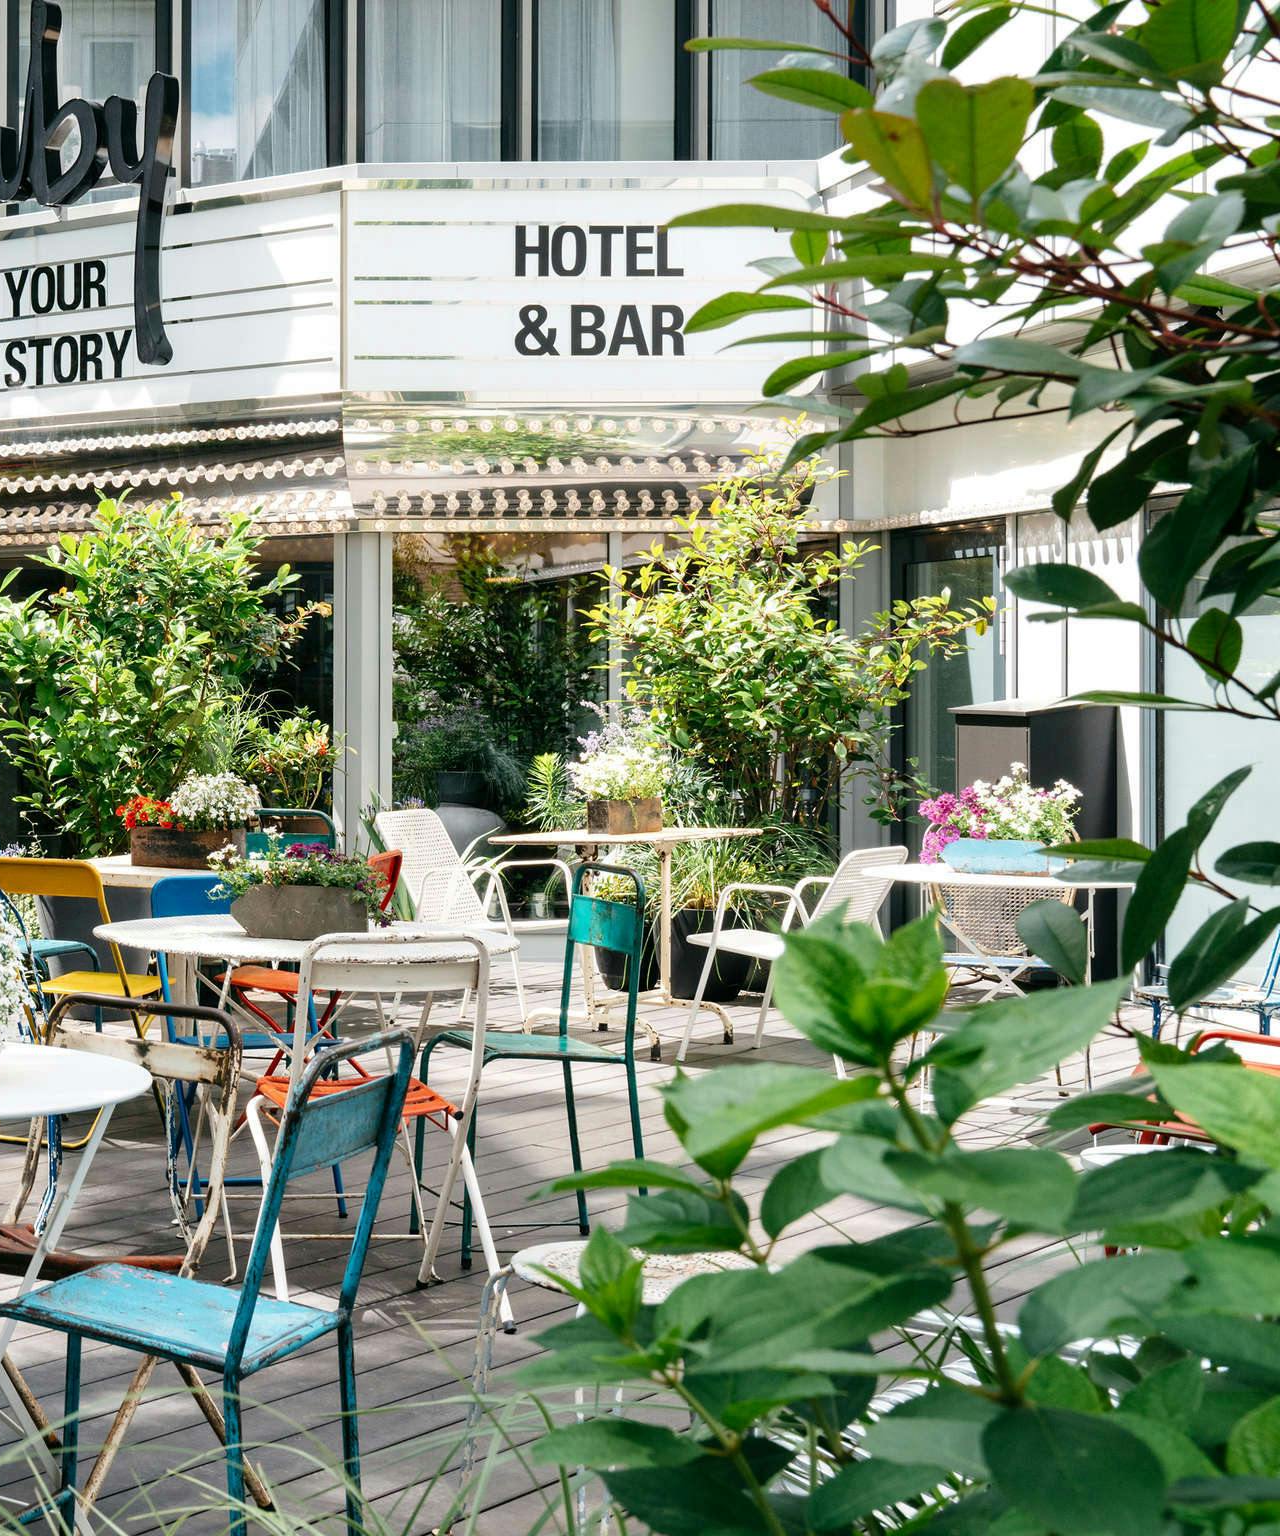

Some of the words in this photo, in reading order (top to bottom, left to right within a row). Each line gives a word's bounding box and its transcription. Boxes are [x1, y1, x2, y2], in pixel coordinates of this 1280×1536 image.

[515, 225, 684, 277] HOTEL
[5, 260, 107, 317] YOUR
[515, 304, 560, 356] &
[570, 304, 685, 356] BAR
[4, 330, 132, 388] STORY
